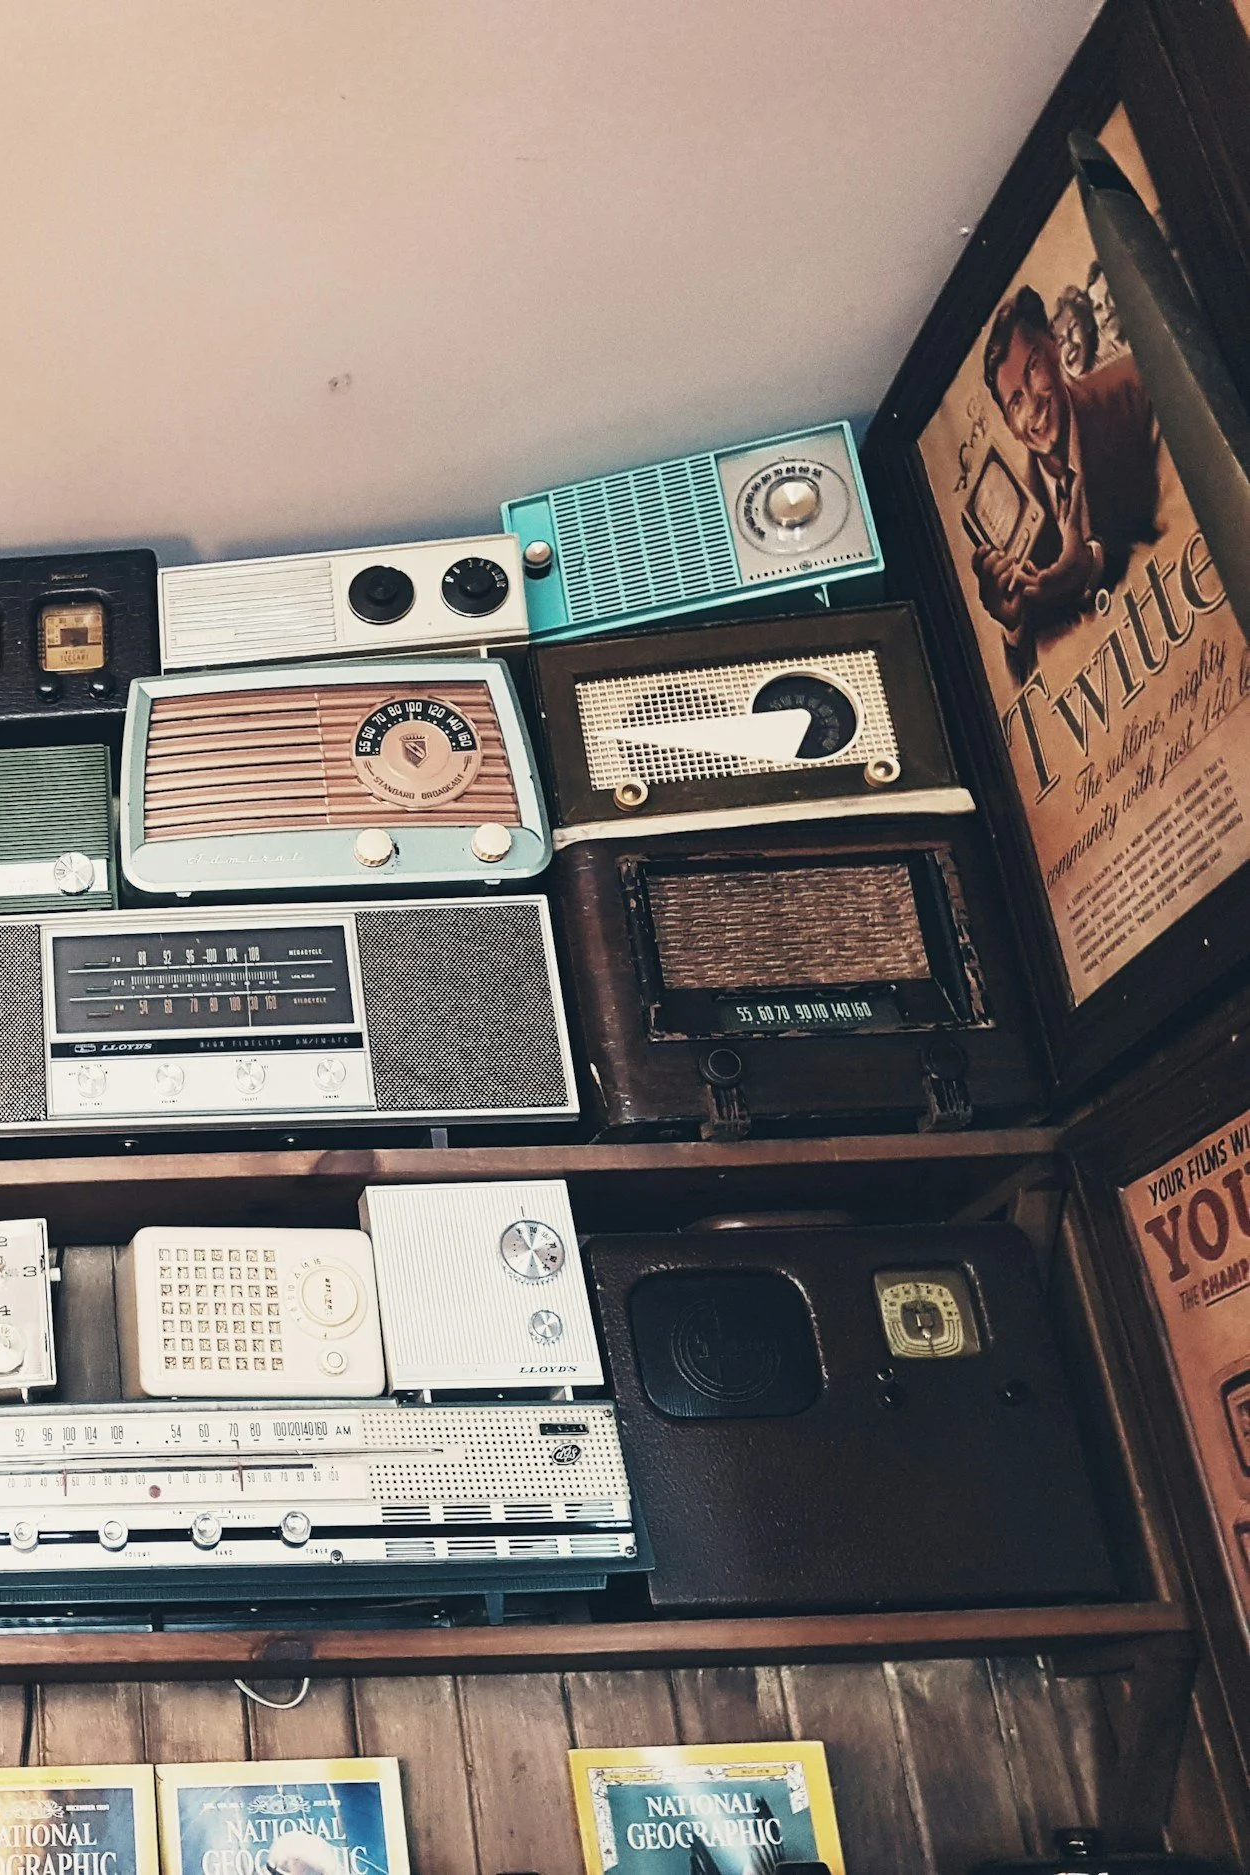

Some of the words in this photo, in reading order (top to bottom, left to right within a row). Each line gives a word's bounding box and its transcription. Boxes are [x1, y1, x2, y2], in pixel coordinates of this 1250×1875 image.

[1001, 532, 1226, 804] Twitte
[387, 703, 402, 717] 80
[404, 702, 422, 713] 100
[428, 703, 446, 718] 120
[372, 712, 387, 726] 70
[446, 714, 463, 732] 140
[1075, 762, 1102, 815] The
[1106, 715, 1165, 783] sublime,
[1170, 639, 1226, 717] mighty
[362, 726, 376, 740] 60
[458, 730, 473, 747] 160
[358, 738, 372, 753] 55
[372, 776, 415, 800] STANDARD
[421, 773, 465, 800] BROADCAST
[1046, 801, 1117, 890] community
[1123, 744, 1156, 813] with
[1158, 719, 1194, 789] just
[1201, 677, 1232, 732] 140
[138, 951, 147, 966] 88
[163, 950, 172, 965] 92
[185, 949, 195, 964] 96
[206, 948, 217, 963] 100
[225, 946, 238, 962] 104
[249, 946, 260, 961] 108
[190, 998, 199, 1013] 70
[230, 996, 241, 1011] 100
[736, 1006, 753, 1022] 55
[757, 1005, 774, 1021] 60
[773, 1005, 790, 1021] 70
[794, 1004, 812, 1020] 90
[810, 1003, 829, 1019] 110
[830, 1002, 851, 1018] 140
[850, 1002, 872, 1017] 160
[101, 1043, 152, 1052] LLOYD'S
[232, 1039, 282, 1047] FIDELITY
[1148, 1167, 1186, 1206] YOUR
[1187, 1138, 1228, 1185] FILMS
[23, 1266, 37, 1277] 3
[1179, 1285, 1199, 1313] THE
[519, 1365, 578, 1374] LLOYD'S
[15, 1428, 25, 1442] 92
[42, 1427, 53, 1441] 96
[63, 1427, 76, 1441] 100
[84, 1426, 97, 1440] 104
[110, 1425, 124, 1440] 108
[171, 1424, 182, 1438] 54
[199, 1423, 210, 1437] 60
[229, 1423, 239, 1437] 70
[250, 1423, 261, 1437] 80
[273, 1423, 287, 1437] 100
[287, 1422, 300, 1436] 120
[301, 1421, 314, 1435] 140
[314, 1421, 328, 1435] 160
[336, 1426, 351, 1435] AM
[645, 1793, 761, 1818] NATIONAL
[225, 1817, 347, 1843] NATIONAL
[627, 1818, 784, 1850] GEOGRAPHIC
